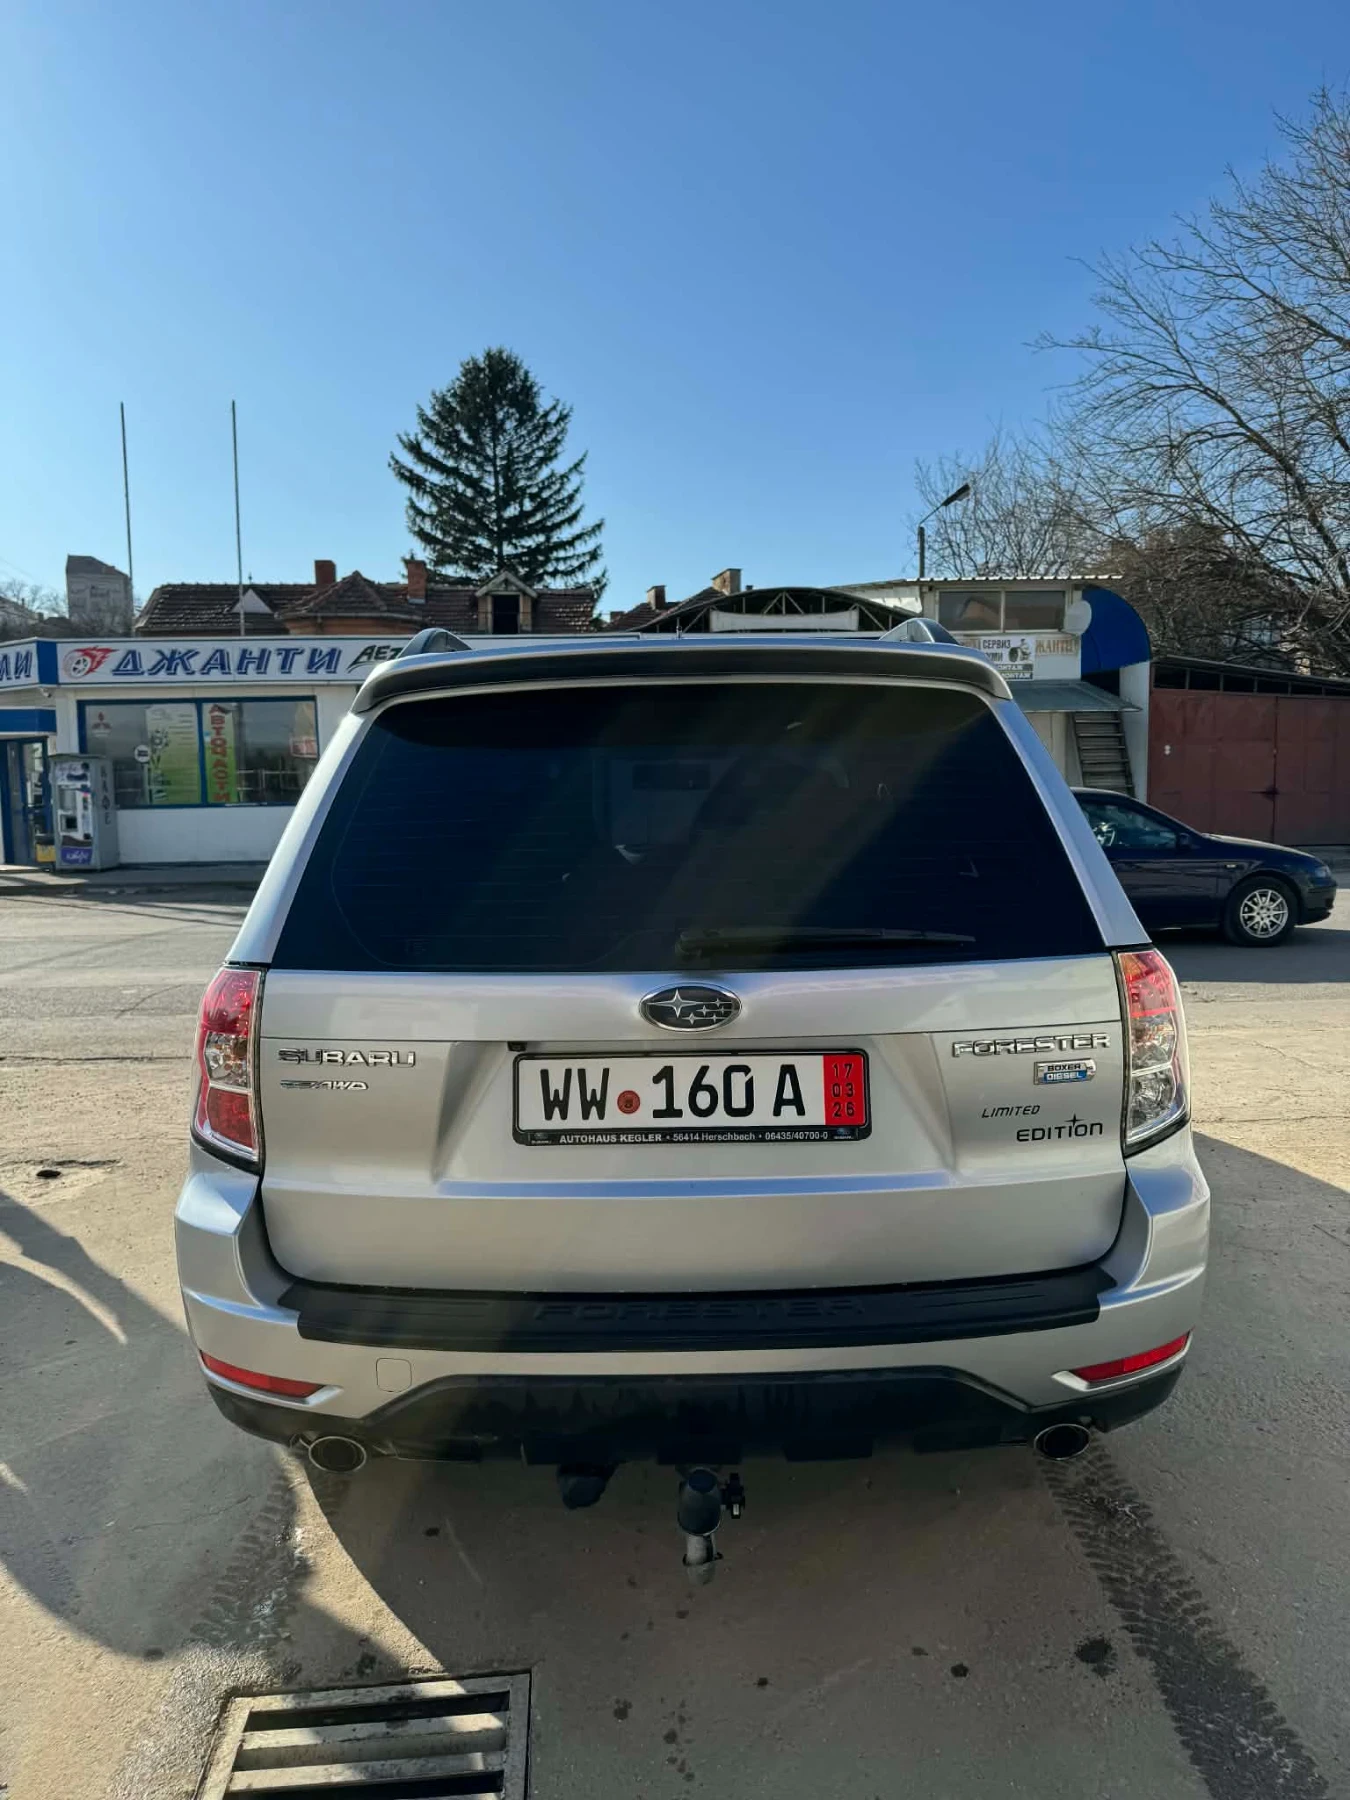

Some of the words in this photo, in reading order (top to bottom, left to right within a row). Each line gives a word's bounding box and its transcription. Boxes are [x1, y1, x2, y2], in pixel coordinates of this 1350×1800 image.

[983, 639, 1011, 649] СЕРВИЗ
[112, 647, 343, 676] ДЖАНТИ
[951, 1033, 1111, 1058] FORESTER
[278, 1048, 416, 1069] SUBARU
[833, 1062, 853, 1078] 17
[1047, 1063, 1081, 1072] BOXER
[1046, 1071, 1083, 1081] DIESEL
[540, 1068, 610, 1121] WW
[652, 1064, 754, 1118] 160
[772, 1064, 806, 1117] A
[831, 1083, 854, 1098] 03
[833, 1102, 855, 1118] 26
[981, 1105, 1041, 1119] LIMITED
[559, 1134, 617, 1144] AUTOHAUS
[620, 1134, 662, 1143] KEGLER
[673, 1133, 700, 1142] 56414
[765, 1131, 828, 1141] 06435/40700-0
[534, 1298, 864, 1321] FORESTER
